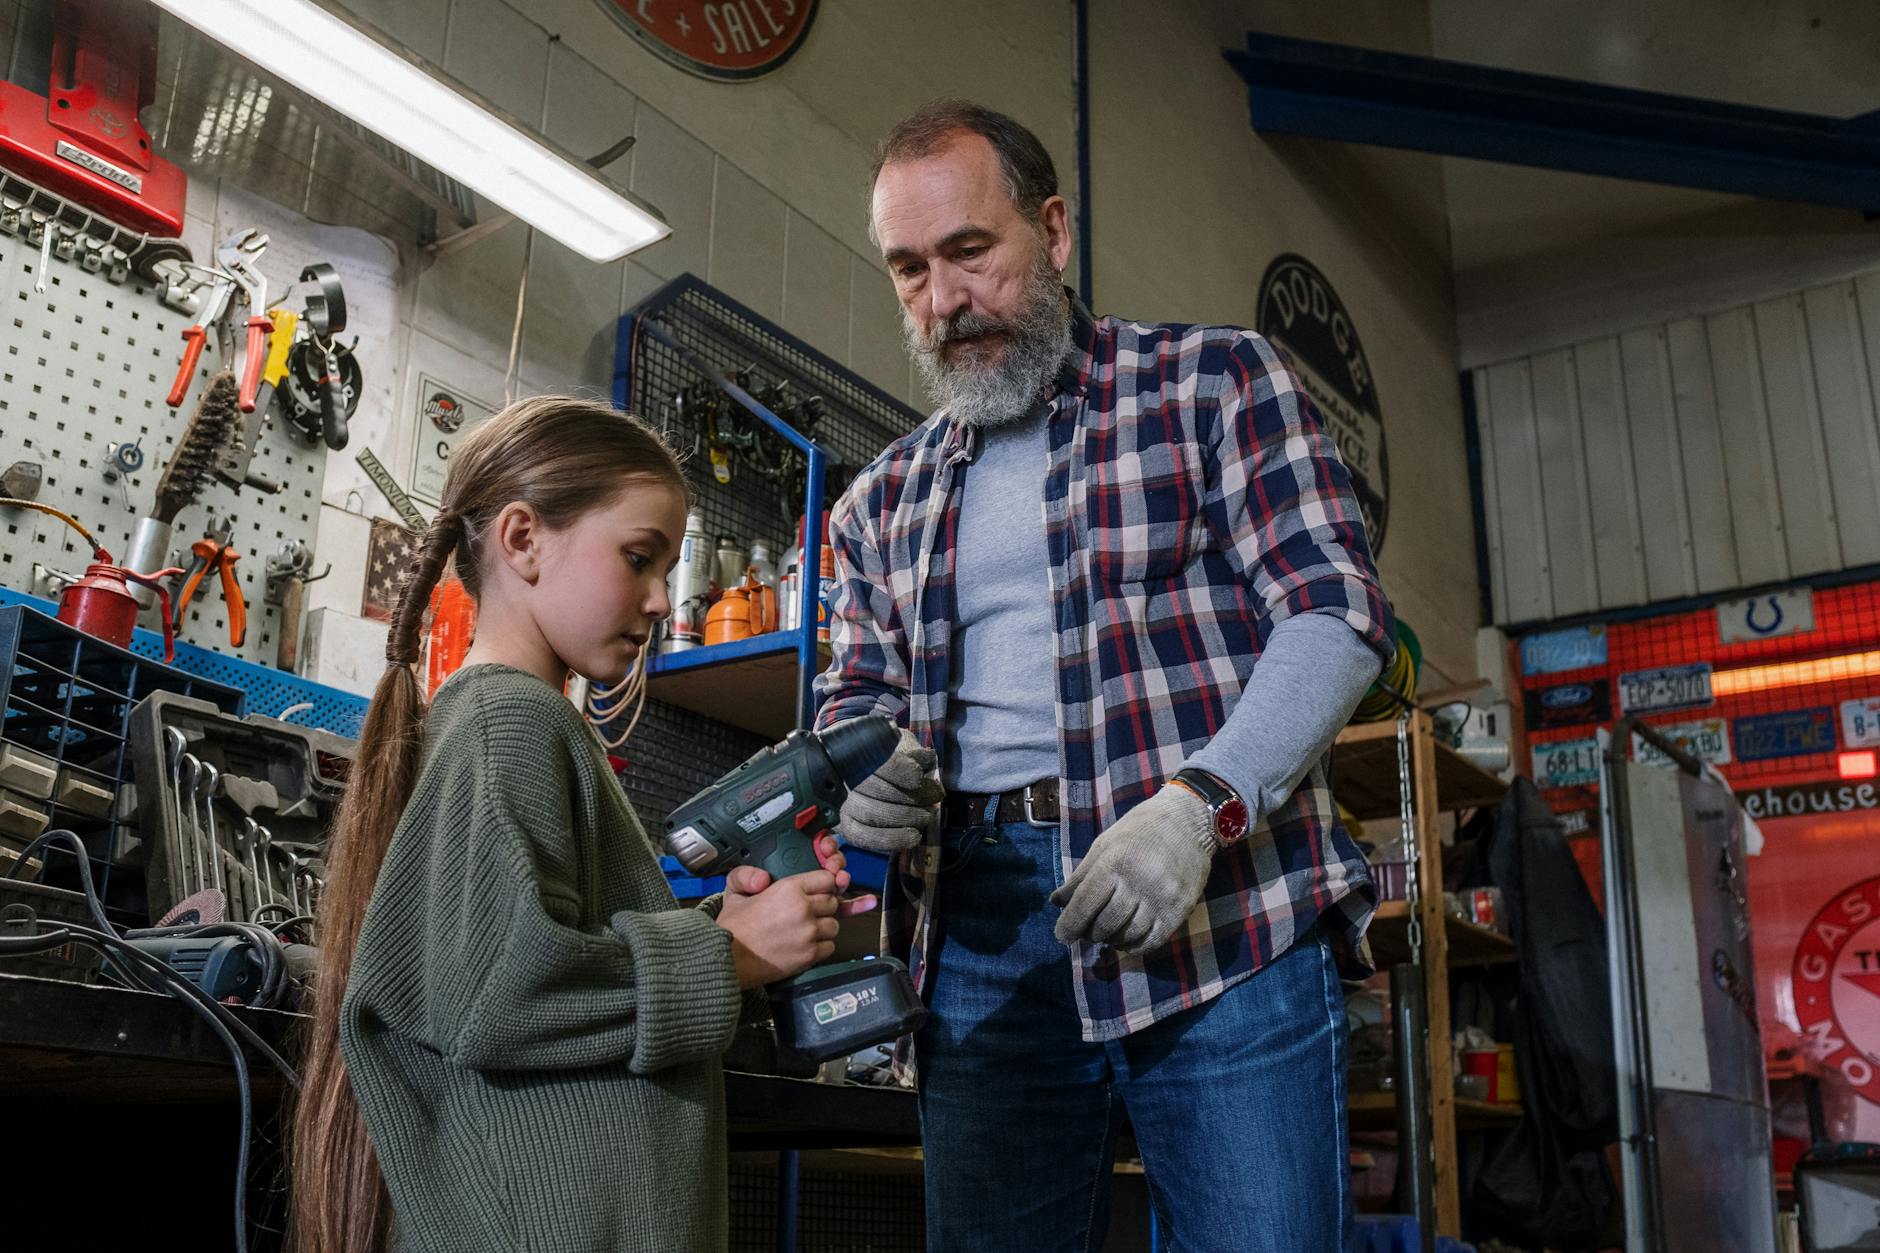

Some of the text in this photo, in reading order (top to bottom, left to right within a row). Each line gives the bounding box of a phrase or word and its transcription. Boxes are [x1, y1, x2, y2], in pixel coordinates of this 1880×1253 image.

[1271, 268, 1369, 396] DODGE
[1801, 887, 1880, 982] GAS
[856, 986, 876, 1001] 18 V
